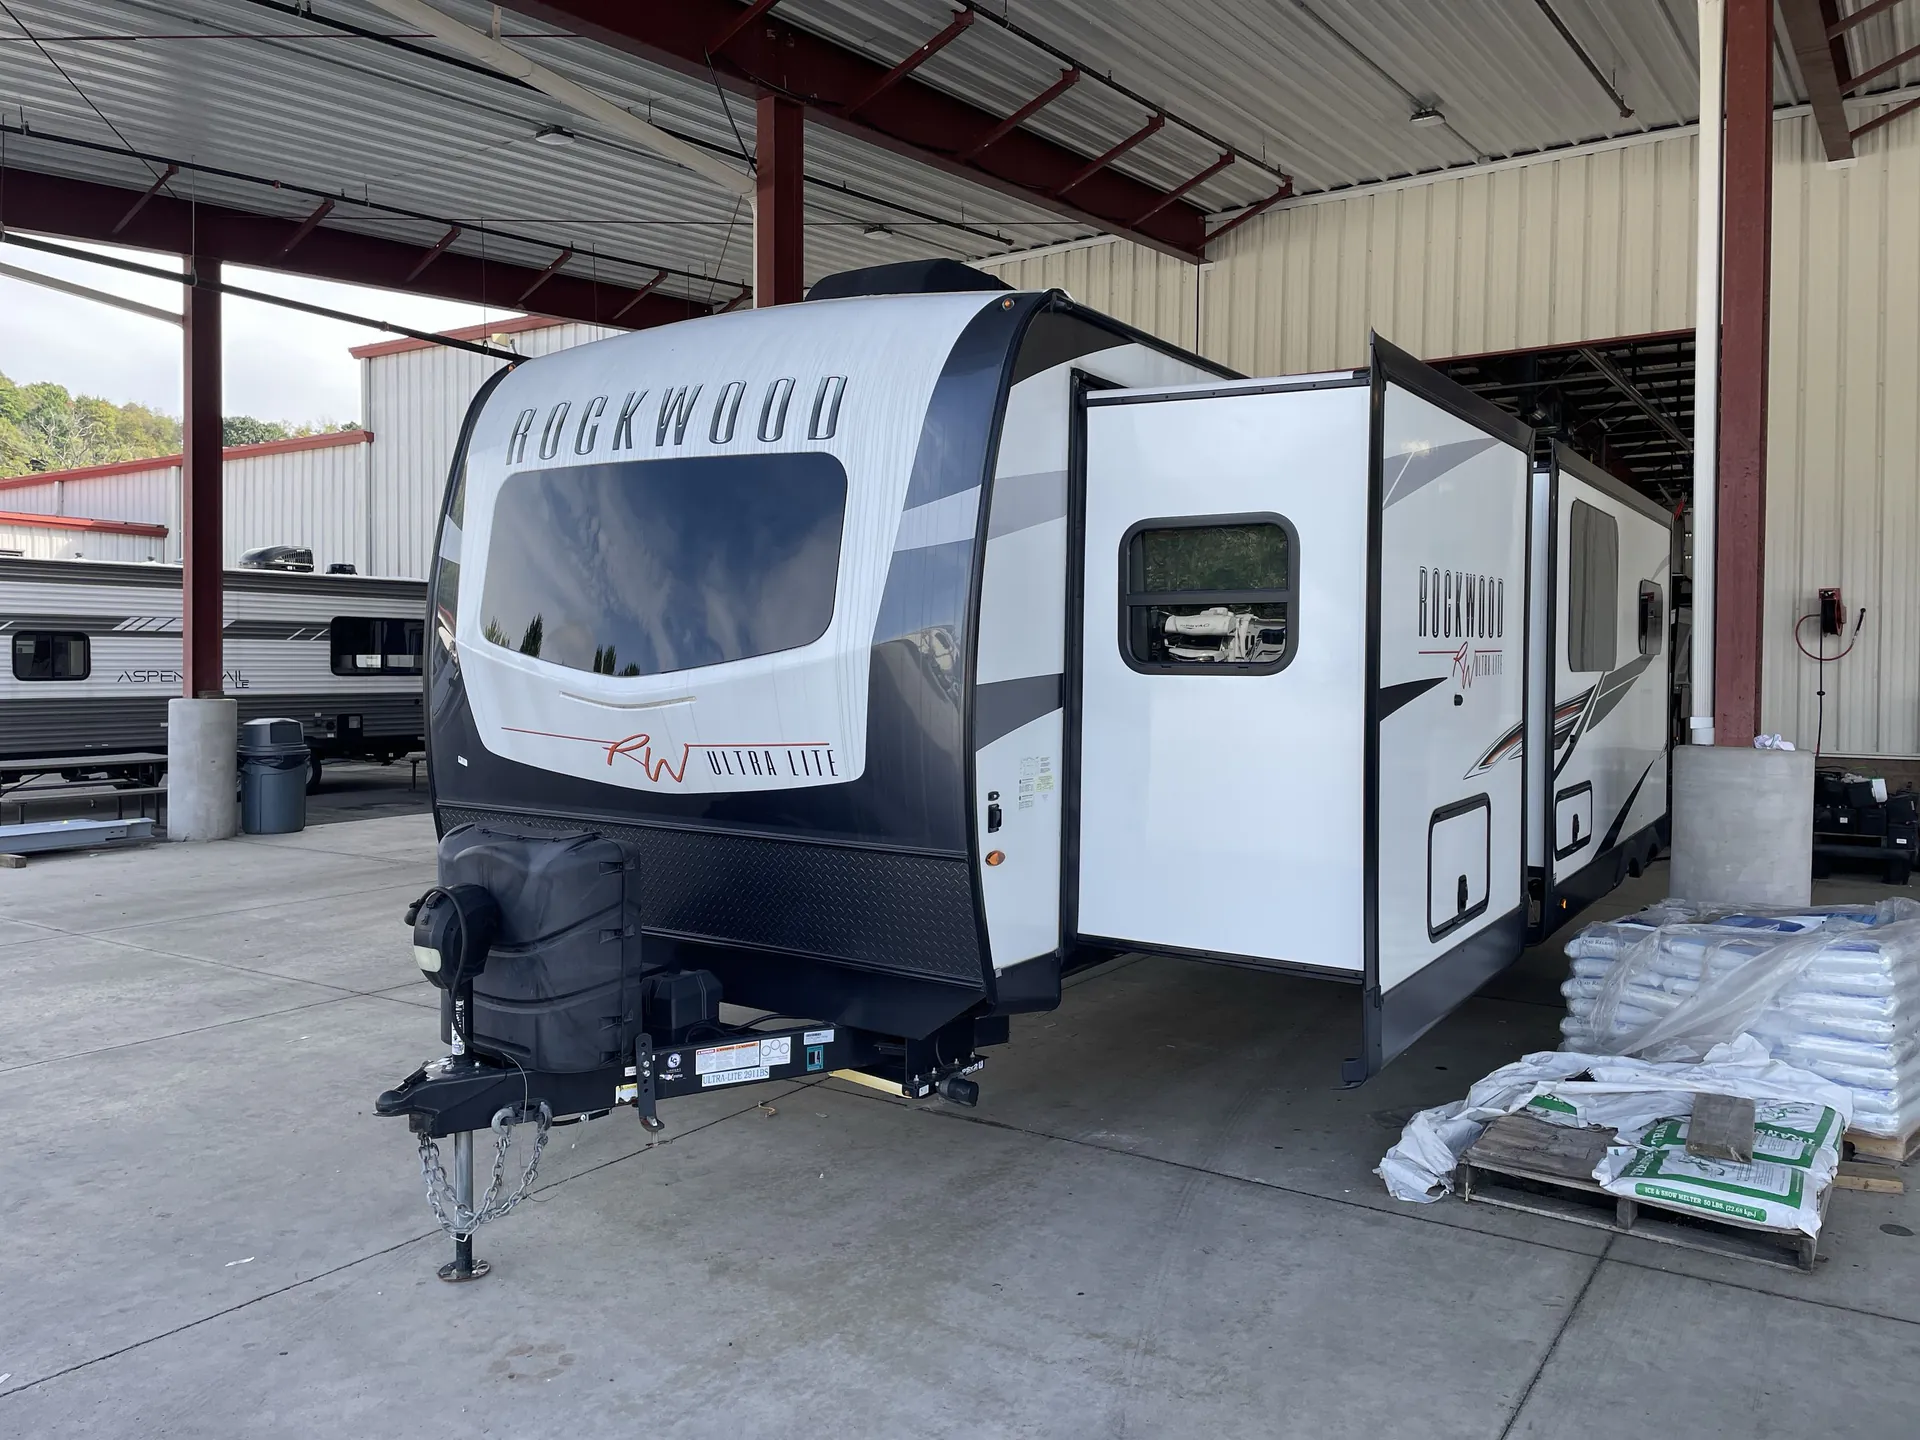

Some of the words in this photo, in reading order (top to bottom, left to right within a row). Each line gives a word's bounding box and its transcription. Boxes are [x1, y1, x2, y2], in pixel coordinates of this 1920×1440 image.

[505, 375, 848, 466] ROCKWOOD
[1419, 566, 1504, 638] ROCKWOOD
[117, 670, 183, 682] ASPEN
[602, 733, 690, 783] RW
[706, 750, 777, 776] ULTRA
[787, 750, 839, 777] LITE
[702, 1070, 743, 1085] ULTRA-LITE
[1644, 1186, 1655, 1195] ICE
[1660, 1190, 1678, 1199] SNOW
[1678, 1193, 1702, 1205] MELTER
[1703, 1199, 1711, 1207] 50
